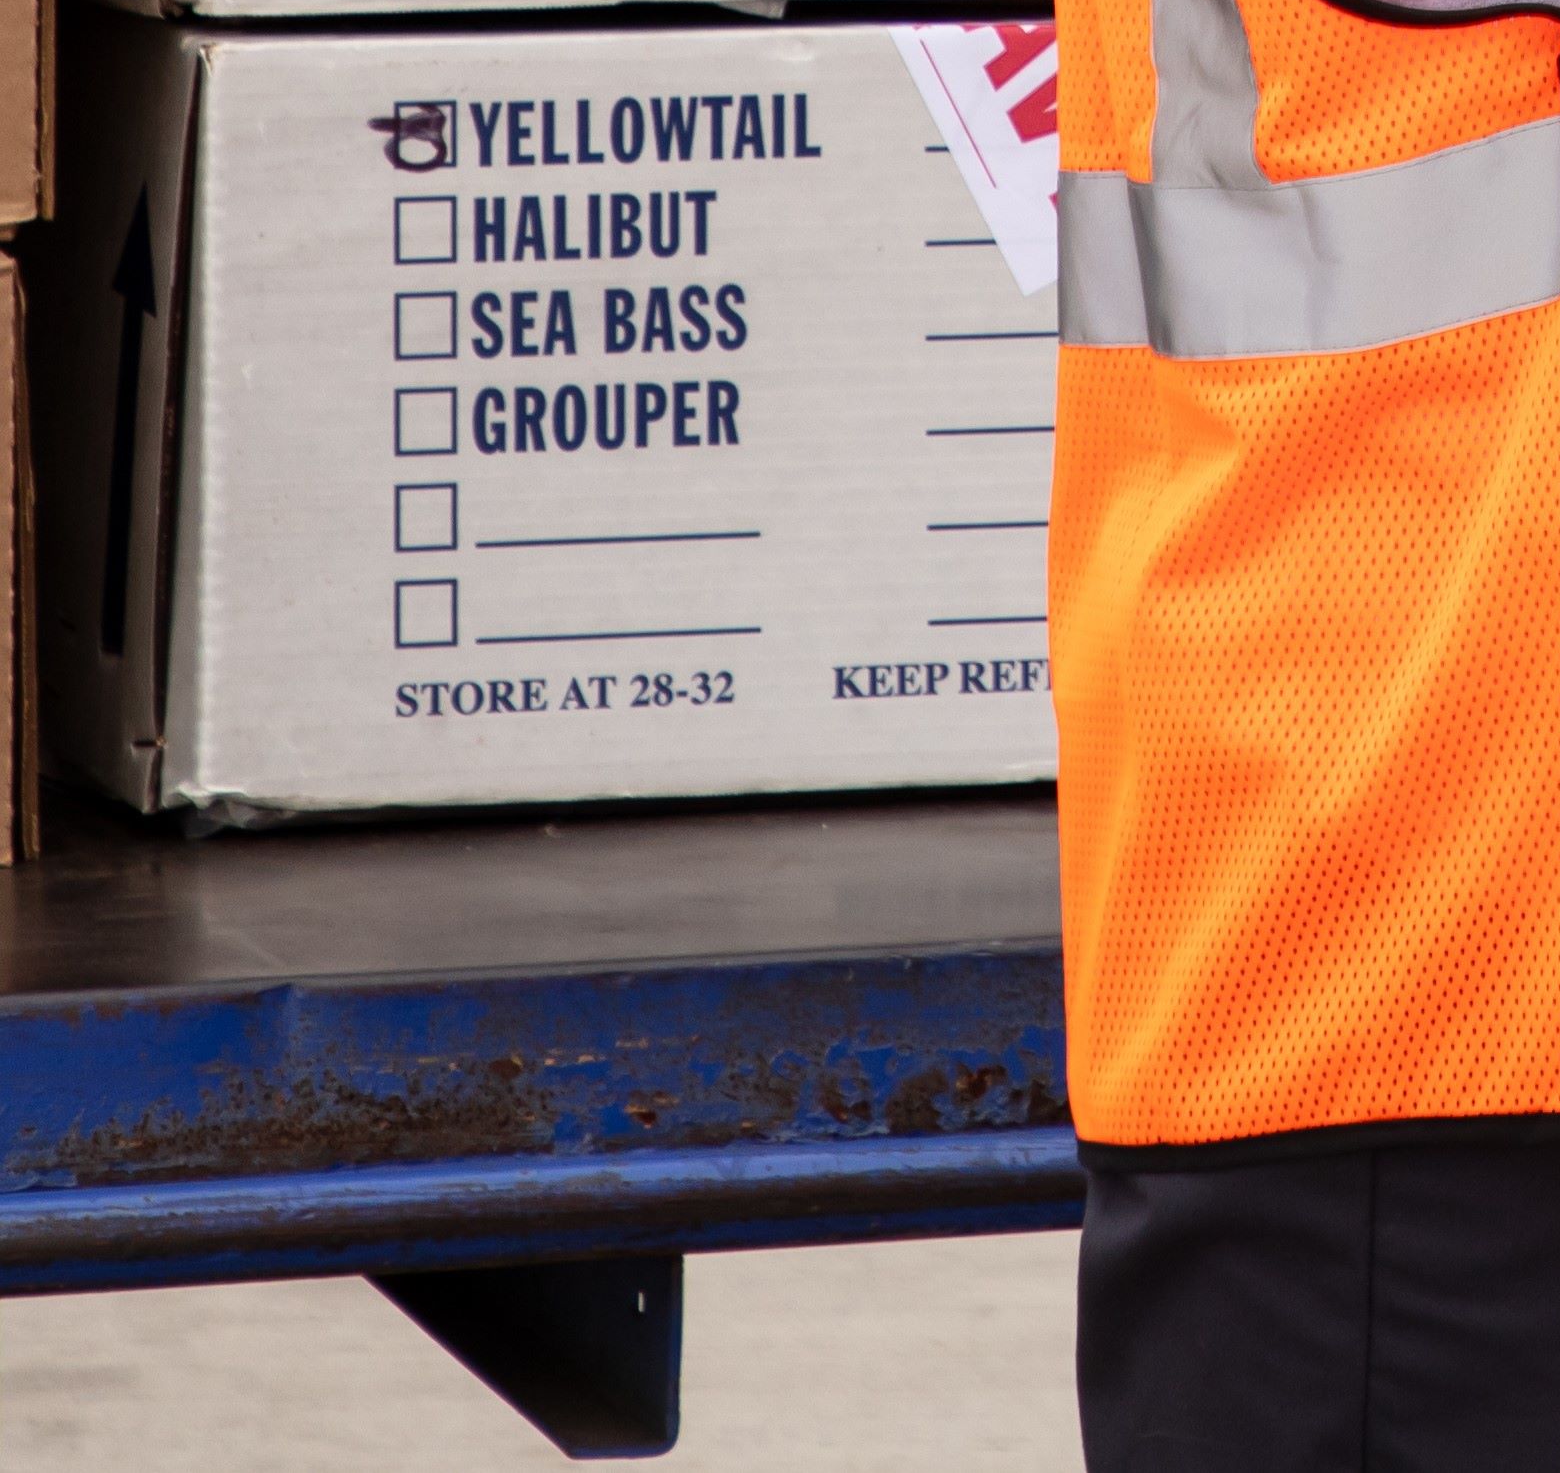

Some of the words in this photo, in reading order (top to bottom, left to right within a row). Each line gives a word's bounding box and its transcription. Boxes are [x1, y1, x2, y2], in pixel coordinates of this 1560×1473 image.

[469, 93, 822, 167] YELLOWTAIL
[474, 190, 717, 263] HALIBUT
[471, 289, 577, 359] SEA
[604, 283, 748, 354] BASS
[473, 379, 740, 454] GROUPER
[396, 678, 548, 717] STORE
[561, 675, 617, 710] AT
[631, 670, 735, 707] 28-32
[833, 662, 950, 699] KEEP
